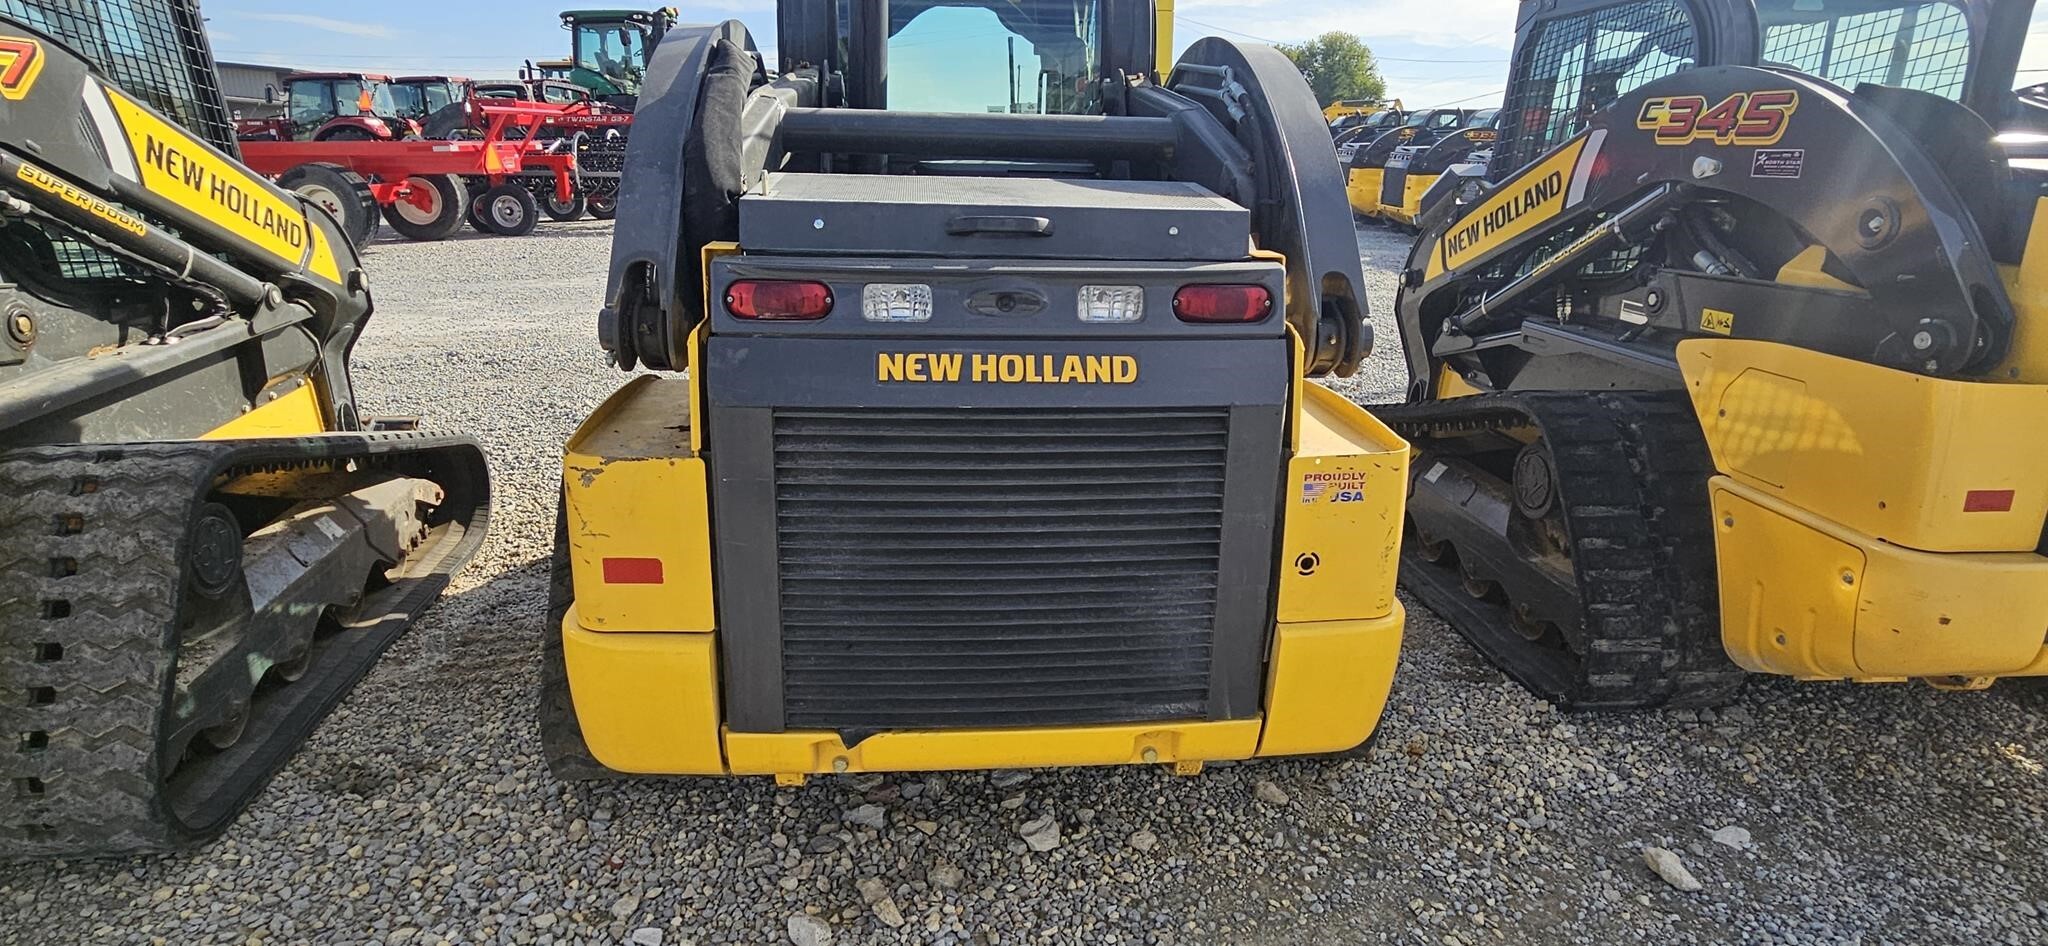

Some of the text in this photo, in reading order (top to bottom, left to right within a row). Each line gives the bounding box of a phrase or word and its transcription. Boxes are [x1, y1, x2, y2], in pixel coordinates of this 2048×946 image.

[1637, 90, 1799, 145] C345
[145, 134, 302, 248] NEW HOLLAND
[1447, 220, 1480, 258] NEW
[1483, 170, 1562, 237] HOLLAND
[878, 353, 1138, 383] NEW HOLLAND
[1303, 472, 1366, 482] PROUDLY
